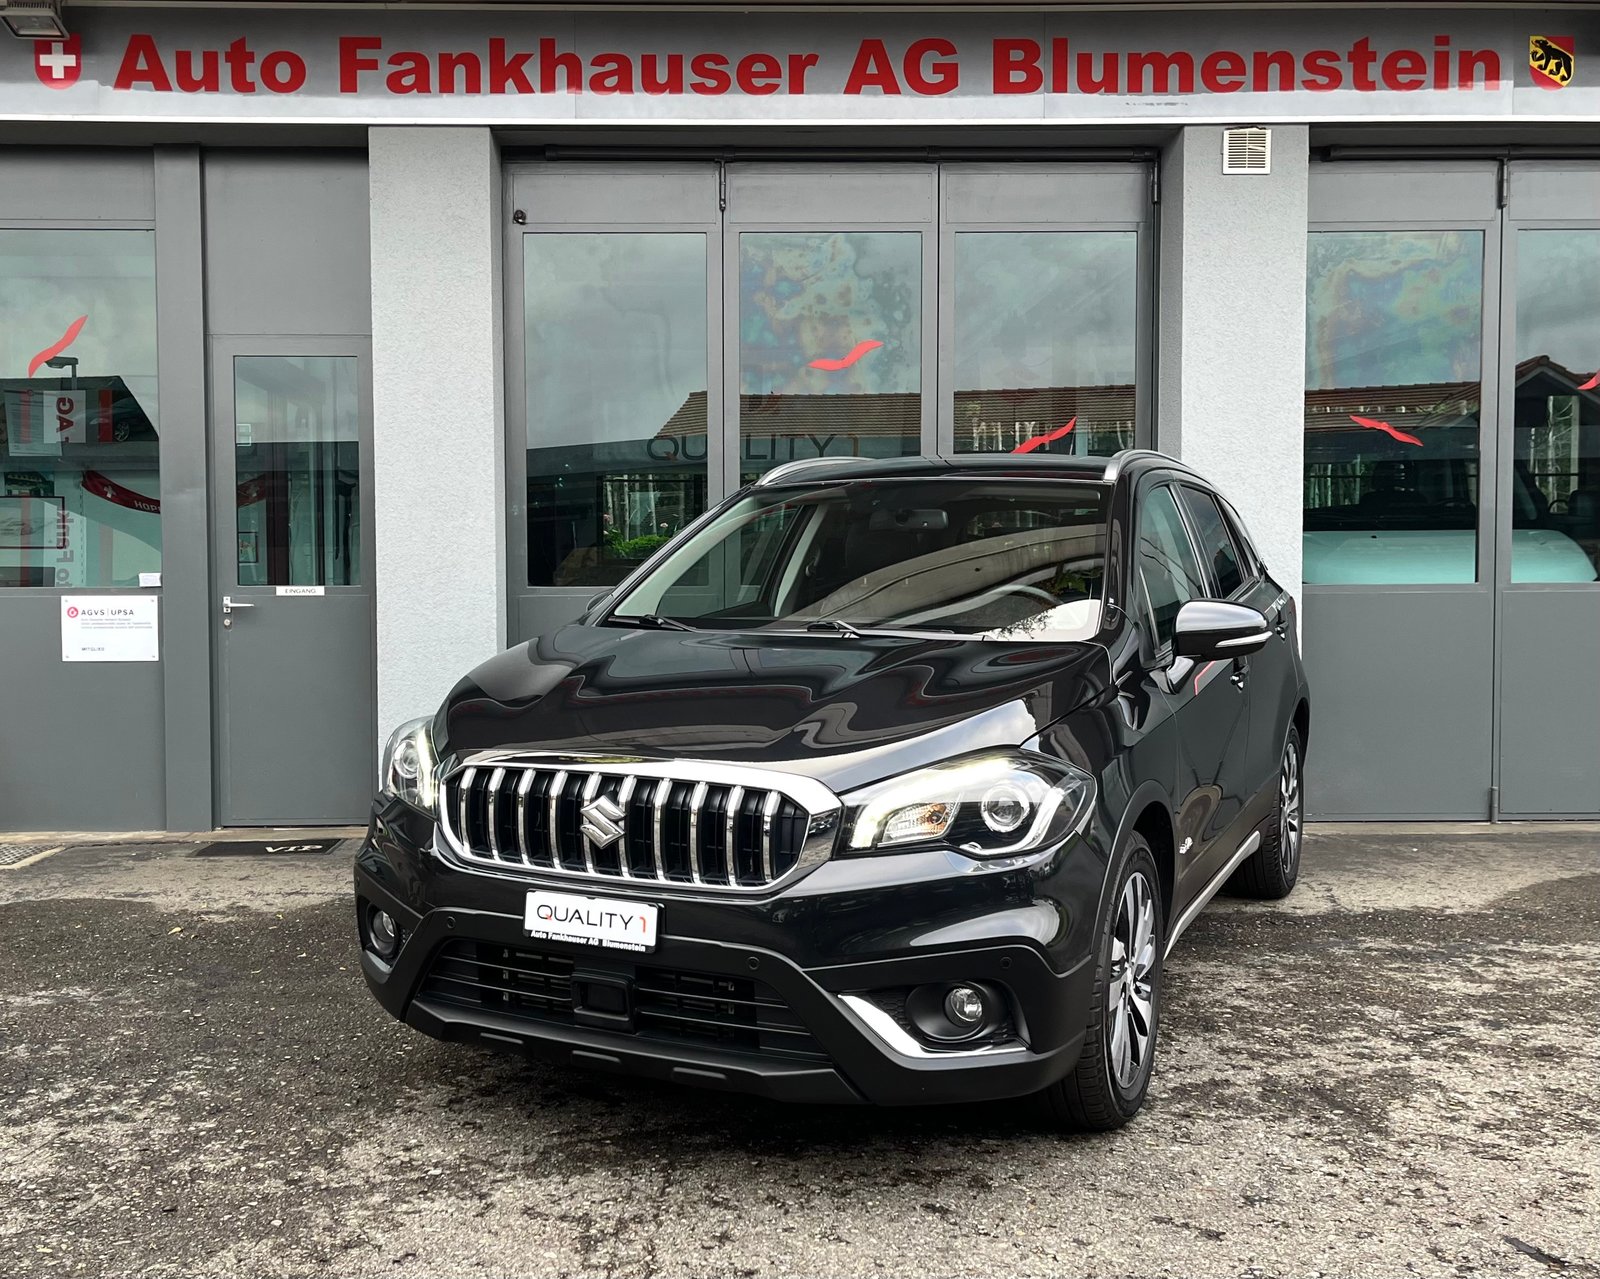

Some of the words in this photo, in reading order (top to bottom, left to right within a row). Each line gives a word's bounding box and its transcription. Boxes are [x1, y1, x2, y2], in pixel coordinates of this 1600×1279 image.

[114, 35, 307, 94] Auto
[339, 37, 819, 96] Fankhauser
[844, 38, 960, 96] AG
[992, 36, 1501, 95] Blumenstein
[647, 434, 838, 462] QULITY
[265, 845, 323, 853] VIP
[536, 904, 634, 931] QUALITY
[530, 930, 547, 939] Auto
[548, 932, 587, 944] Fankhauser
[588, 938, 600, 946] AG
[602, 940, 646, 952] Blumenstein
